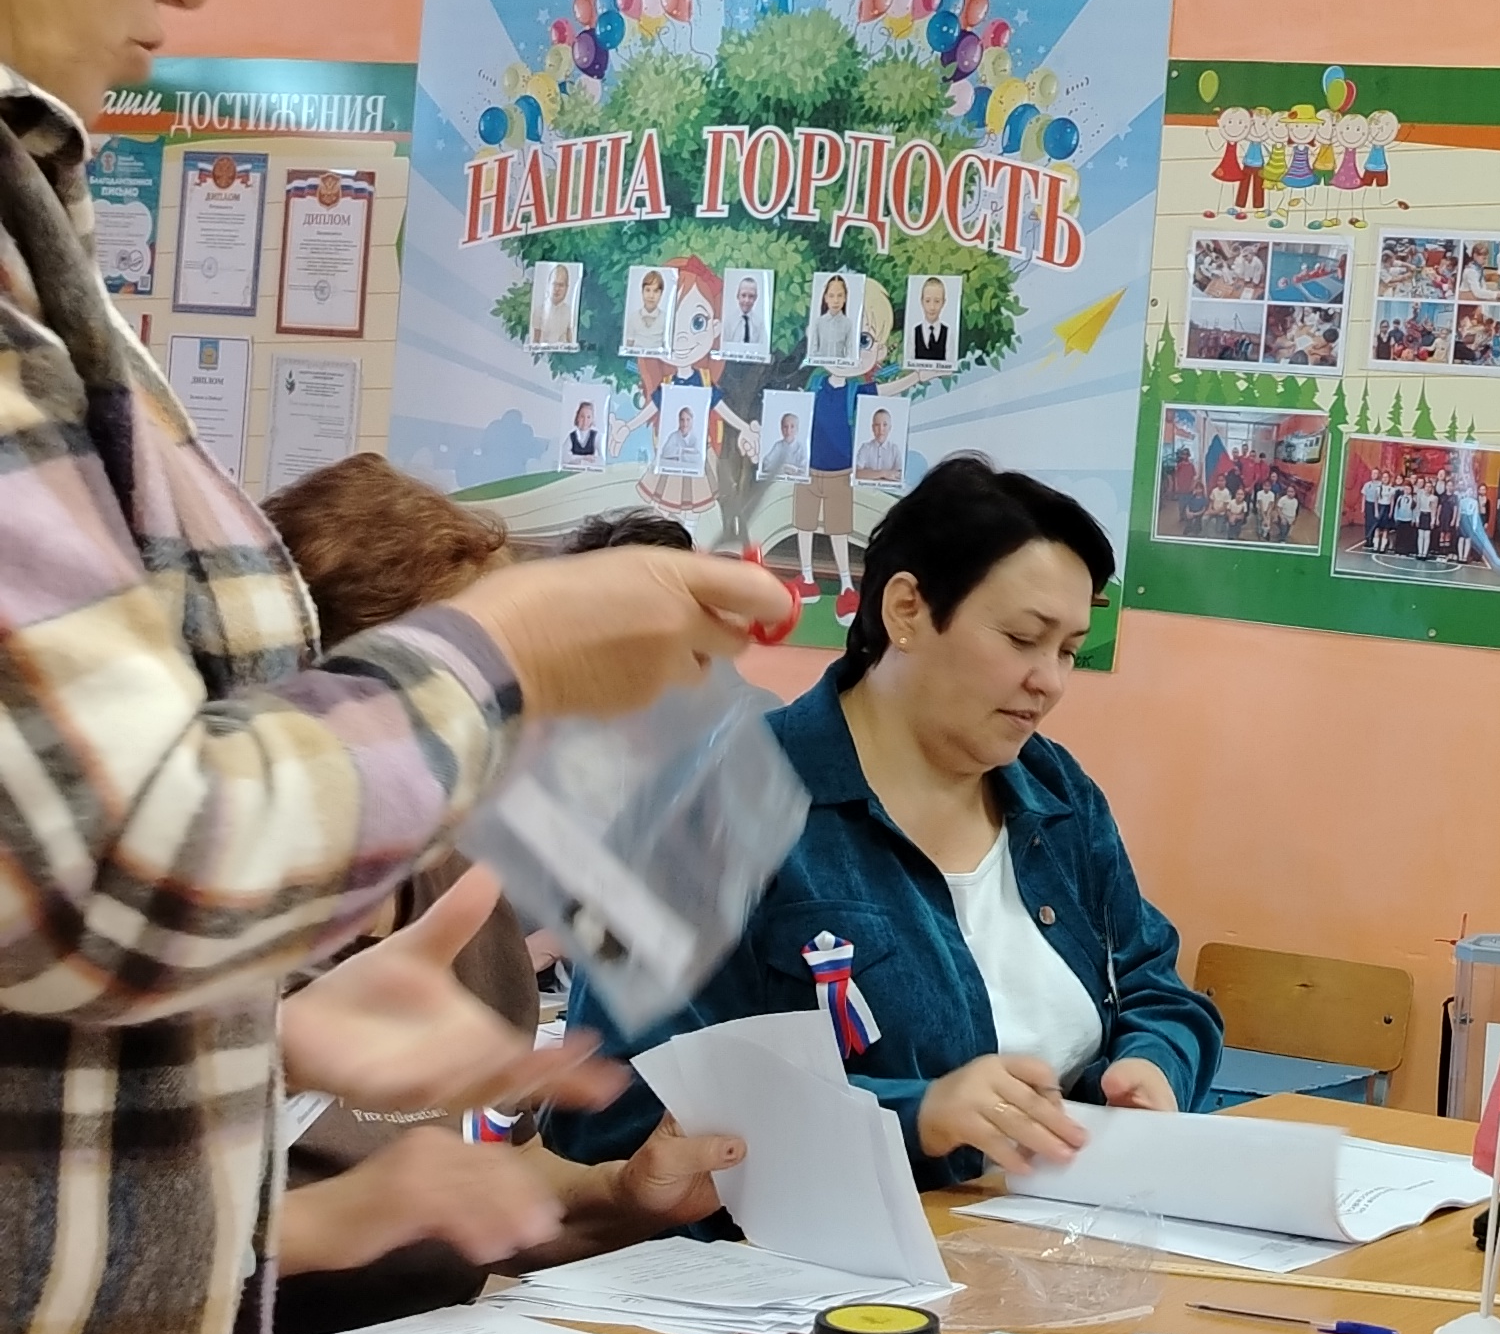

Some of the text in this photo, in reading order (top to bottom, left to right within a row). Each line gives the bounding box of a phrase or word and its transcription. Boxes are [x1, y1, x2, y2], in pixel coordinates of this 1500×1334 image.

[100, 89, 387, 138] аши ДОСТИЖЕНИЯ
[302, 213, 351, 226] ДИПЛОМ
[459, 124, 1085, 272] НАША ГОРДОСТЬ
